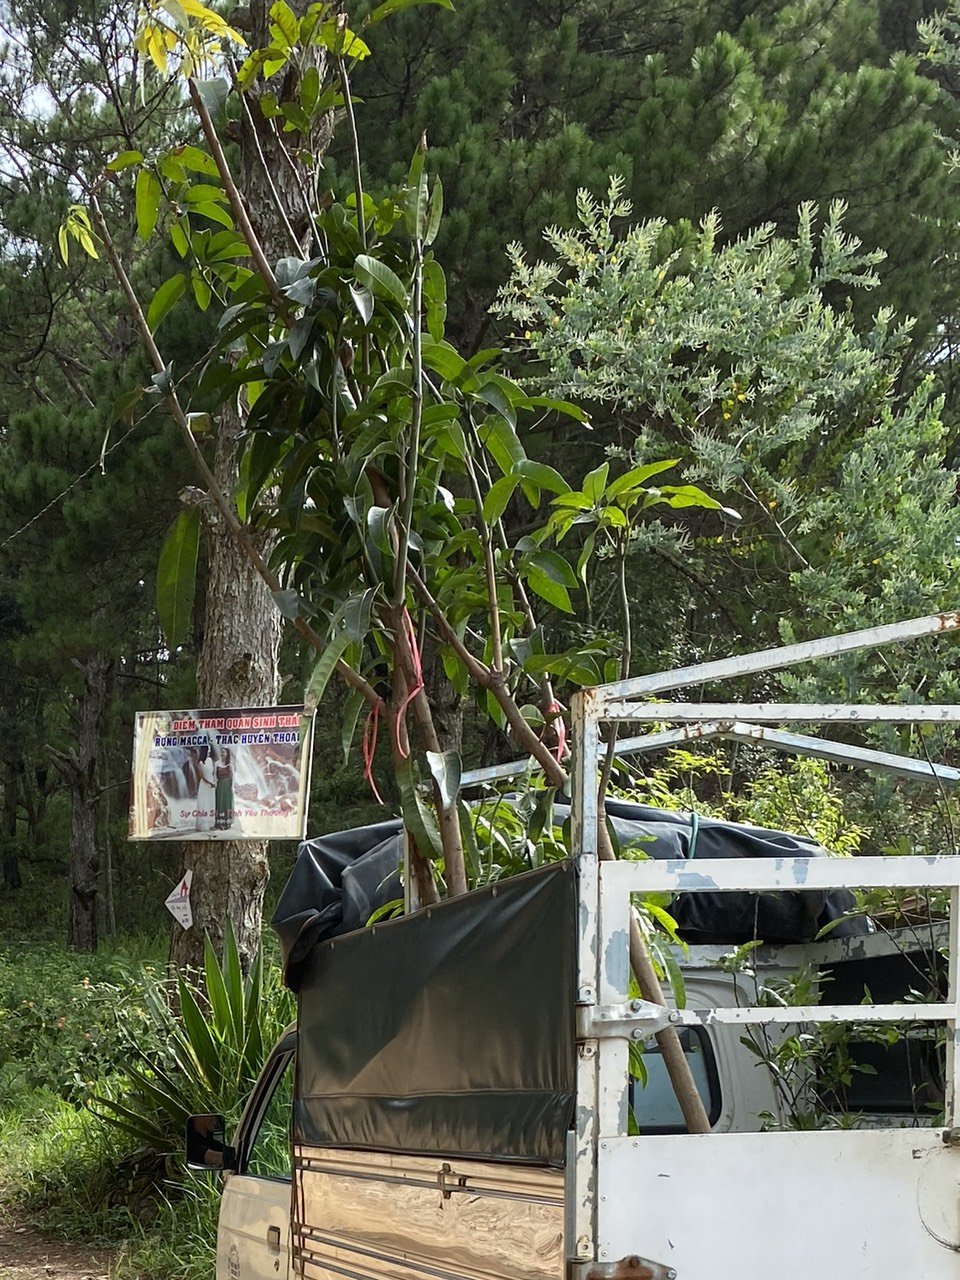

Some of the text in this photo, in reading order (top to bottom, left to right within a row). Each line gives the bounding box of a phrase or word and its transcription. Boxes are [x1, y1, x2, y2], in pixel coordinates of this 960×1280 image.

[198, 718, 224, 730] THAM
[226, 717, 251, 730] QUAN
[252, 715, 277, 728] SINH
[179, 735, 208, 746] MACCA
